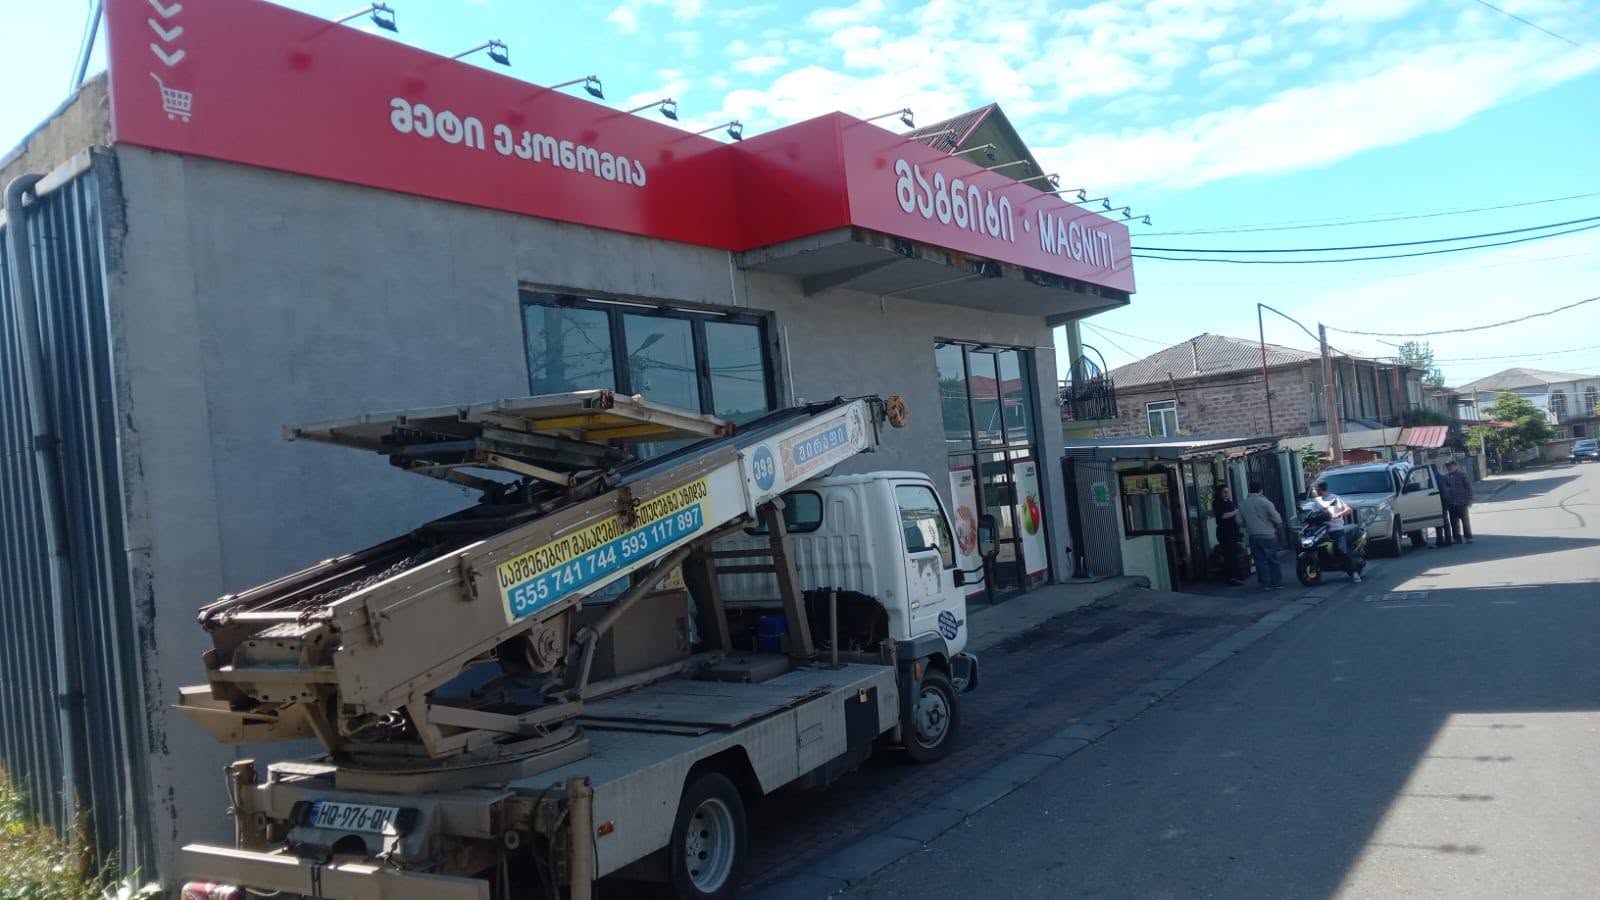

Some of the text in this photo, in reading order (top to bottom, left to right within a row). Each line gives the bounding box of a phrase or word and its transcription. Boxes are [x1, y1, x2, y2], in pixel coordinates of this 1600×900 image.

[389, 96, 647, 188] მეტი ეკონომია
[894, 158, 1116, 272] მაგნიტი MAGNITI
[498, 539, 573, 588] სამშენებლო
[679, 480, 707, 507] აზიდვა
[514, 507, 700, 611] 555 741 744 593 117 897
